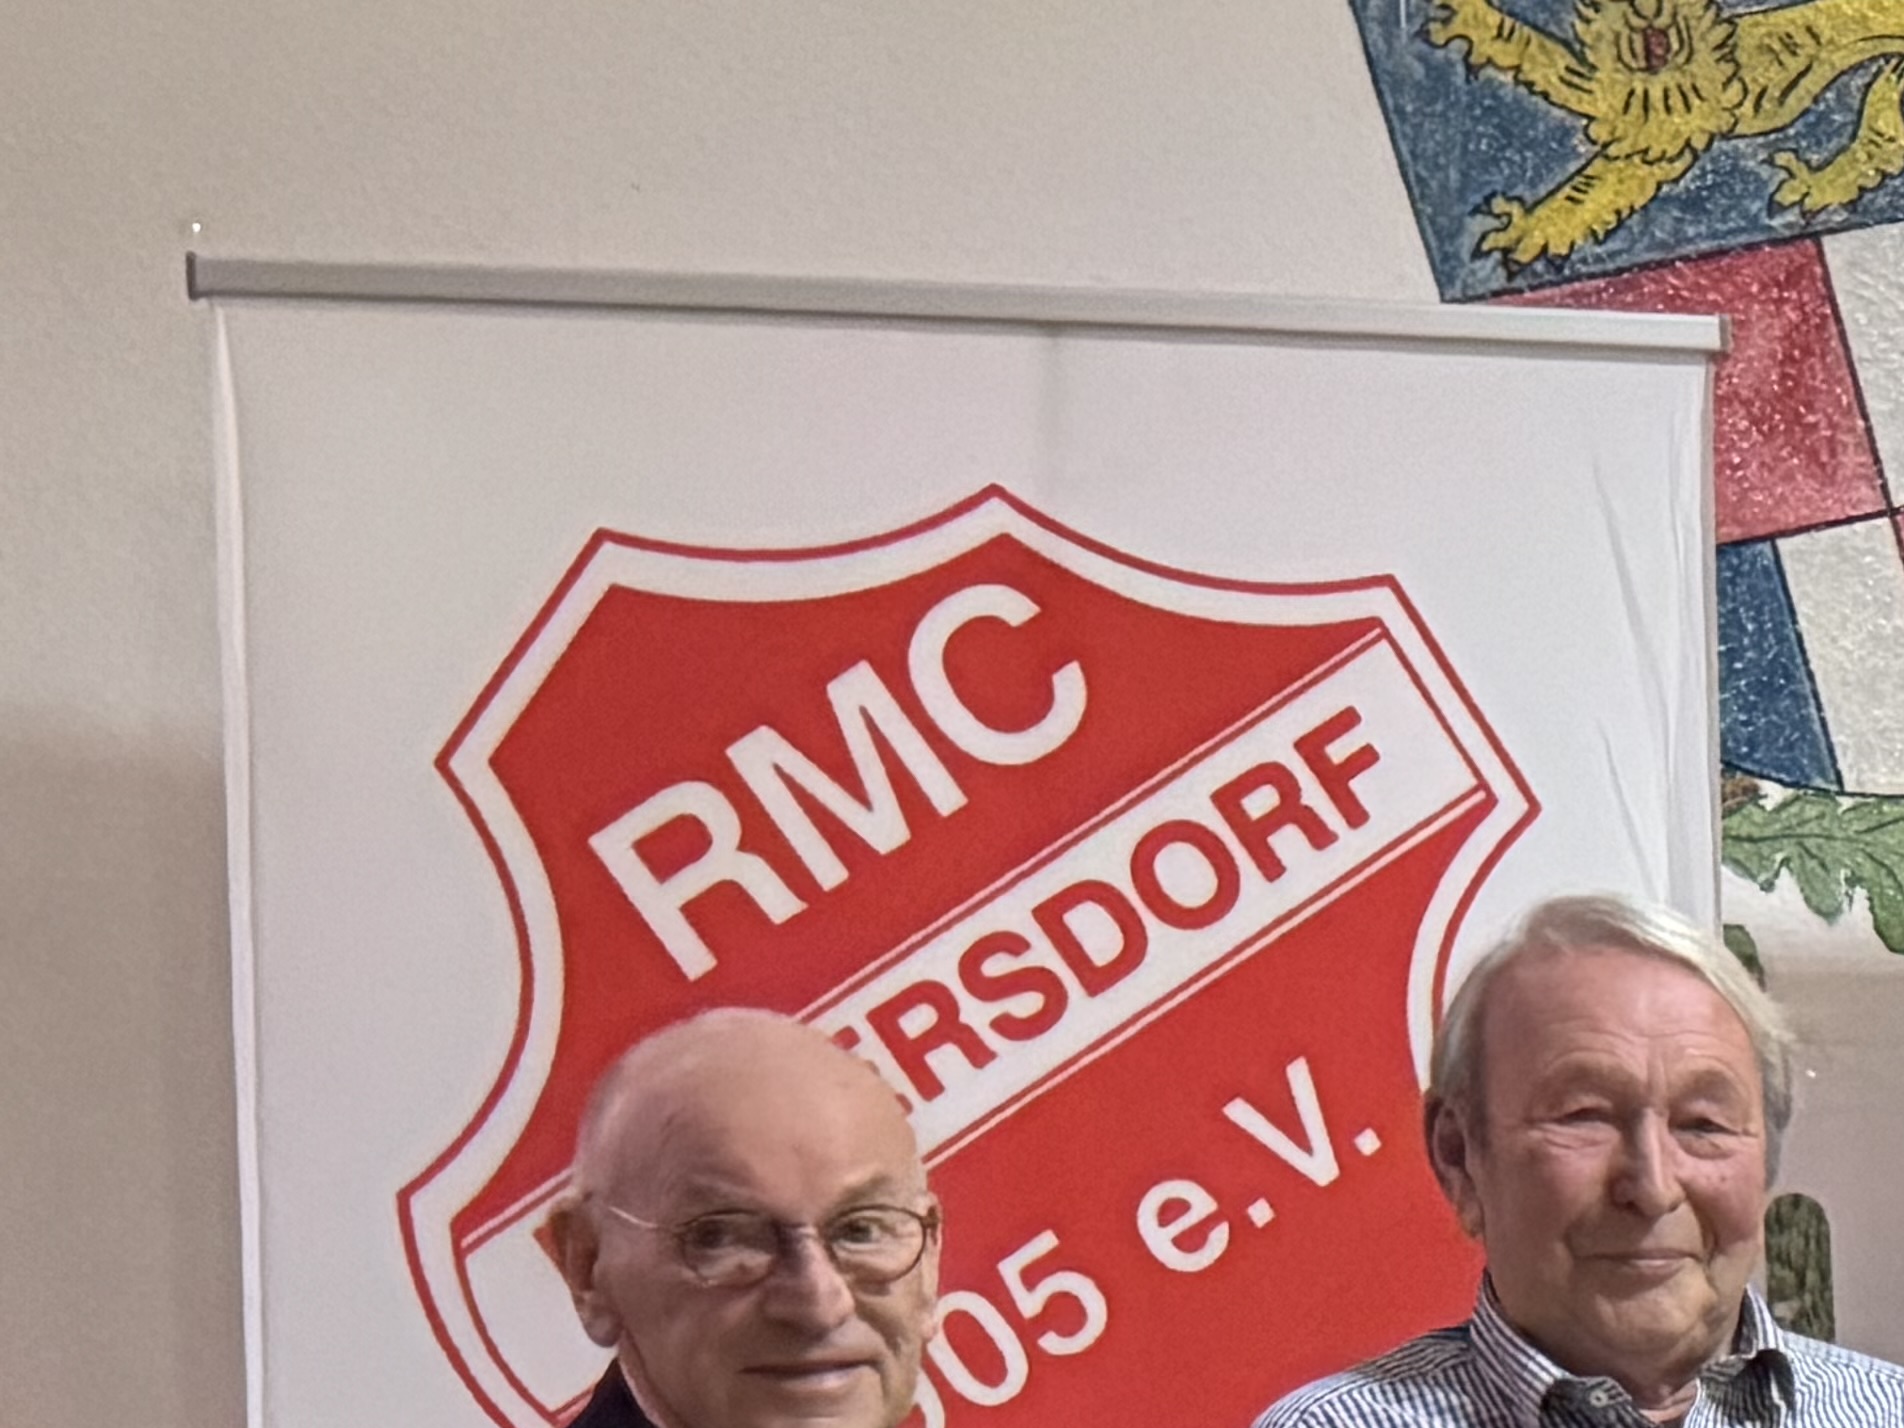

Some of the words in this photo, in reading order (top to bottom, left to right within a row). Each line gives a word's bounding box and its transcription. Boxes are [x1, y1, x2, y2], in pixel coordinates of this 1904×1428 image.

[587, 581, 1090, 983] RMC
[760, 704, 1382, 1140] RSDORF
[1136, 1055, 1382, 1272] e.V.
